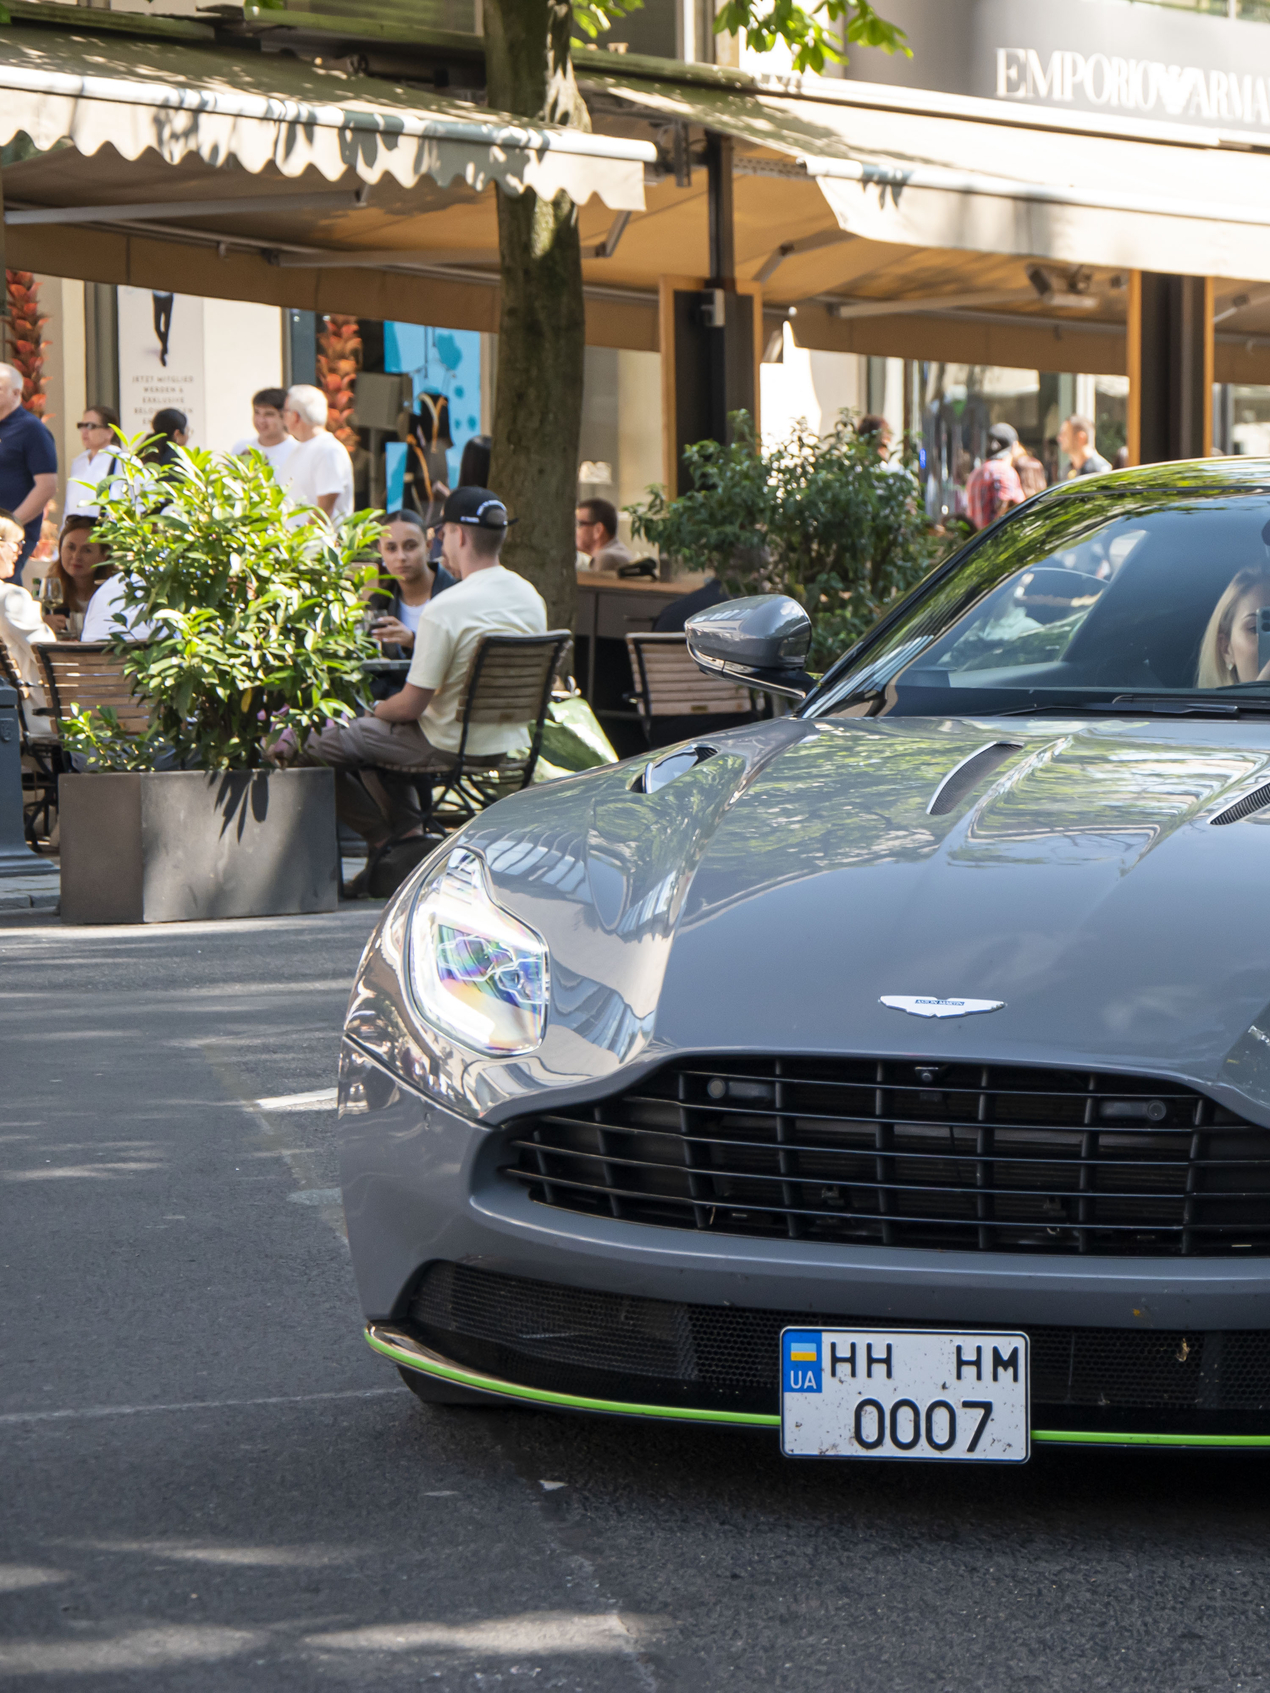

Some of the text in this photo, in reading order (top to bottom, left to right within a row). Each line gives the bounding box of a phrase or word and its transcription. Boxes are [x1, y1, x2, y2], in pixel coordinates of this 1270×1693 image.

[997, 47, 1158, 113] EMPORIO
[132, 375, 194, 383] JETZT MITGLIED
[142, 396, 185, 404] EXKLUSIVE
[830, 1341, 1019, 1383] HH HM
[790, 1370, 817, 1390] UA
[853, 1397, 994, 1453] 0007
